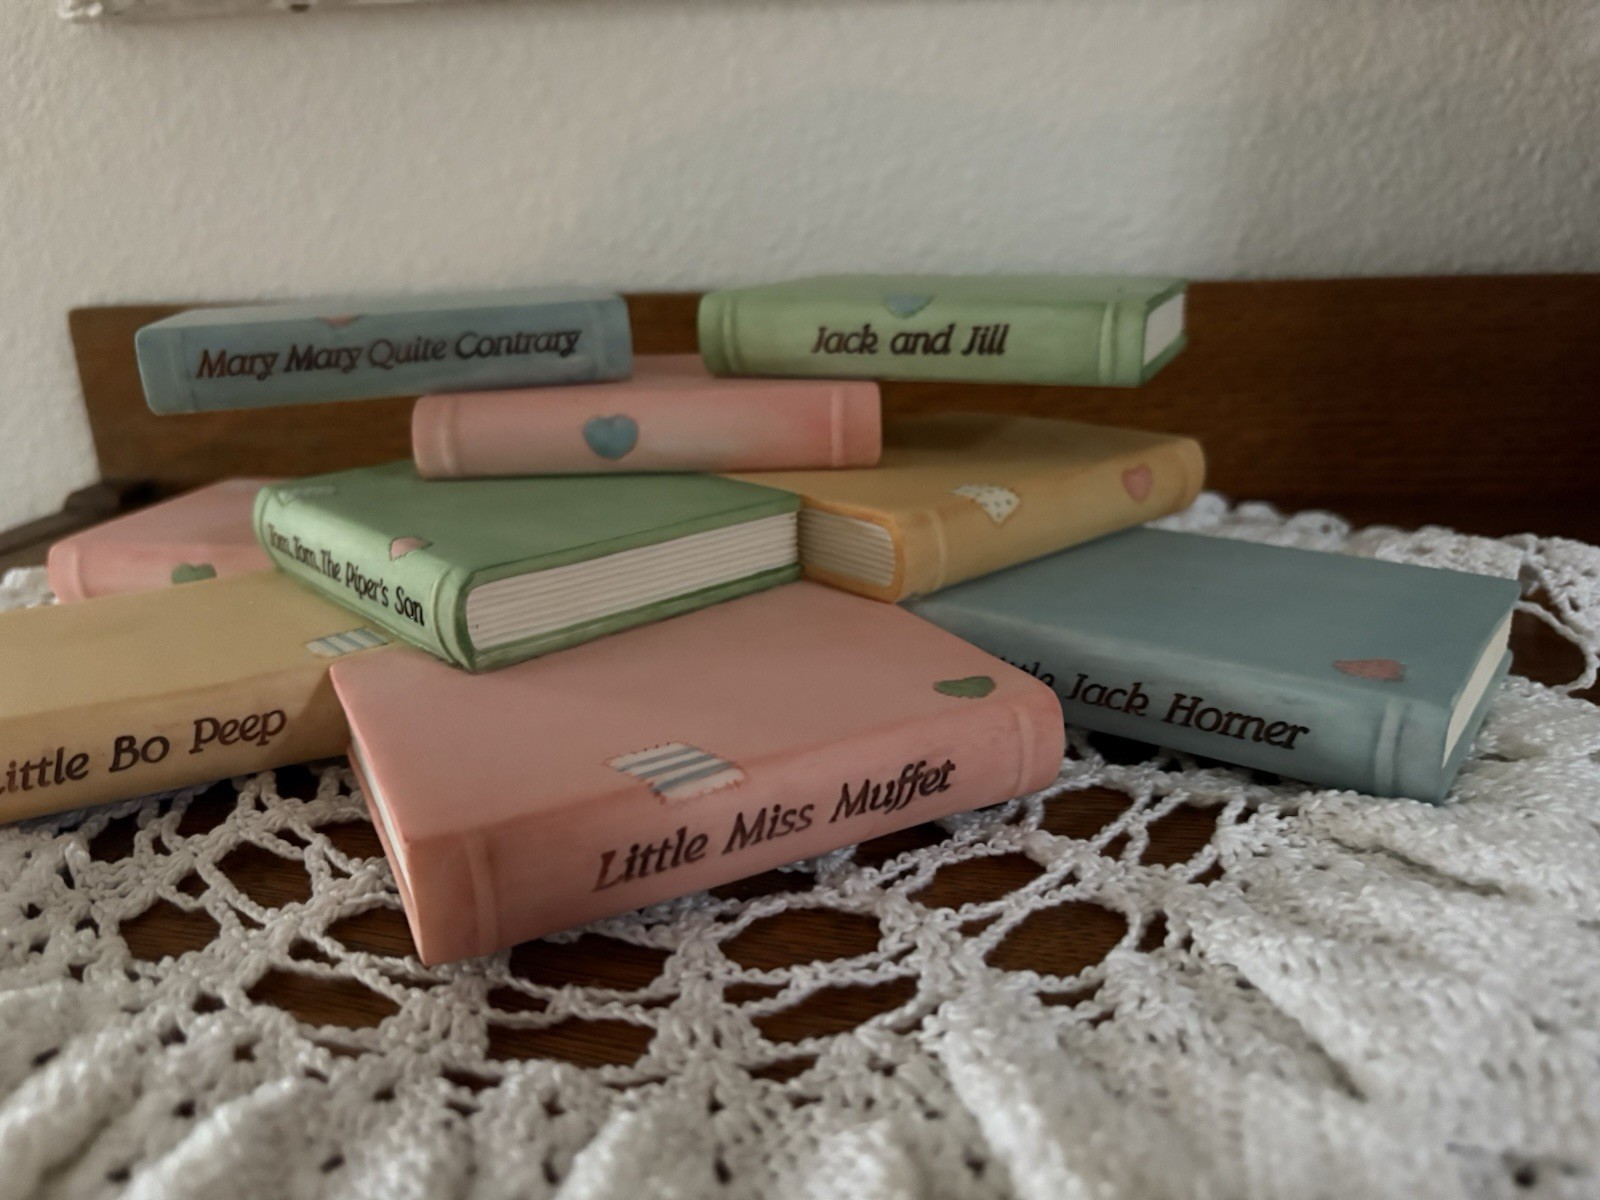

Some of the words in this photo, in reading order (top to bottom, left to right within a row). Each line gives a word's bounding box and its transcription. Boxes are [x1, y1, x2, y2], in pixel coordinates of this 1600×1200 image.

[196, 350, 279, 381] Mary
[284, 344, 363, 373] Mary
[368, 338, 446, 370] Quite
[455, 330, 581, 360] Contrary
[811, 324, 879, 355] Jack
[889, 323, 956, 356] and
[961, 323, 1010, 356] Jill
[320, 549, 342, 582] The
[345, 561, 389, 608] Piper's
[394, 586, 425, 627] Son
[1065, 673, 1150, 717] Jack
[1162, 693, 1311, 750] Horner
[0, 746, 90, 796] ittle
[108, 735, 170, 773] Bo
[188, 709, 287, 755] Peep
[593, 826, 708, 893] Little
[721, 803, 816, 856] Miss
[829, 758, 957, 825] Muffet
